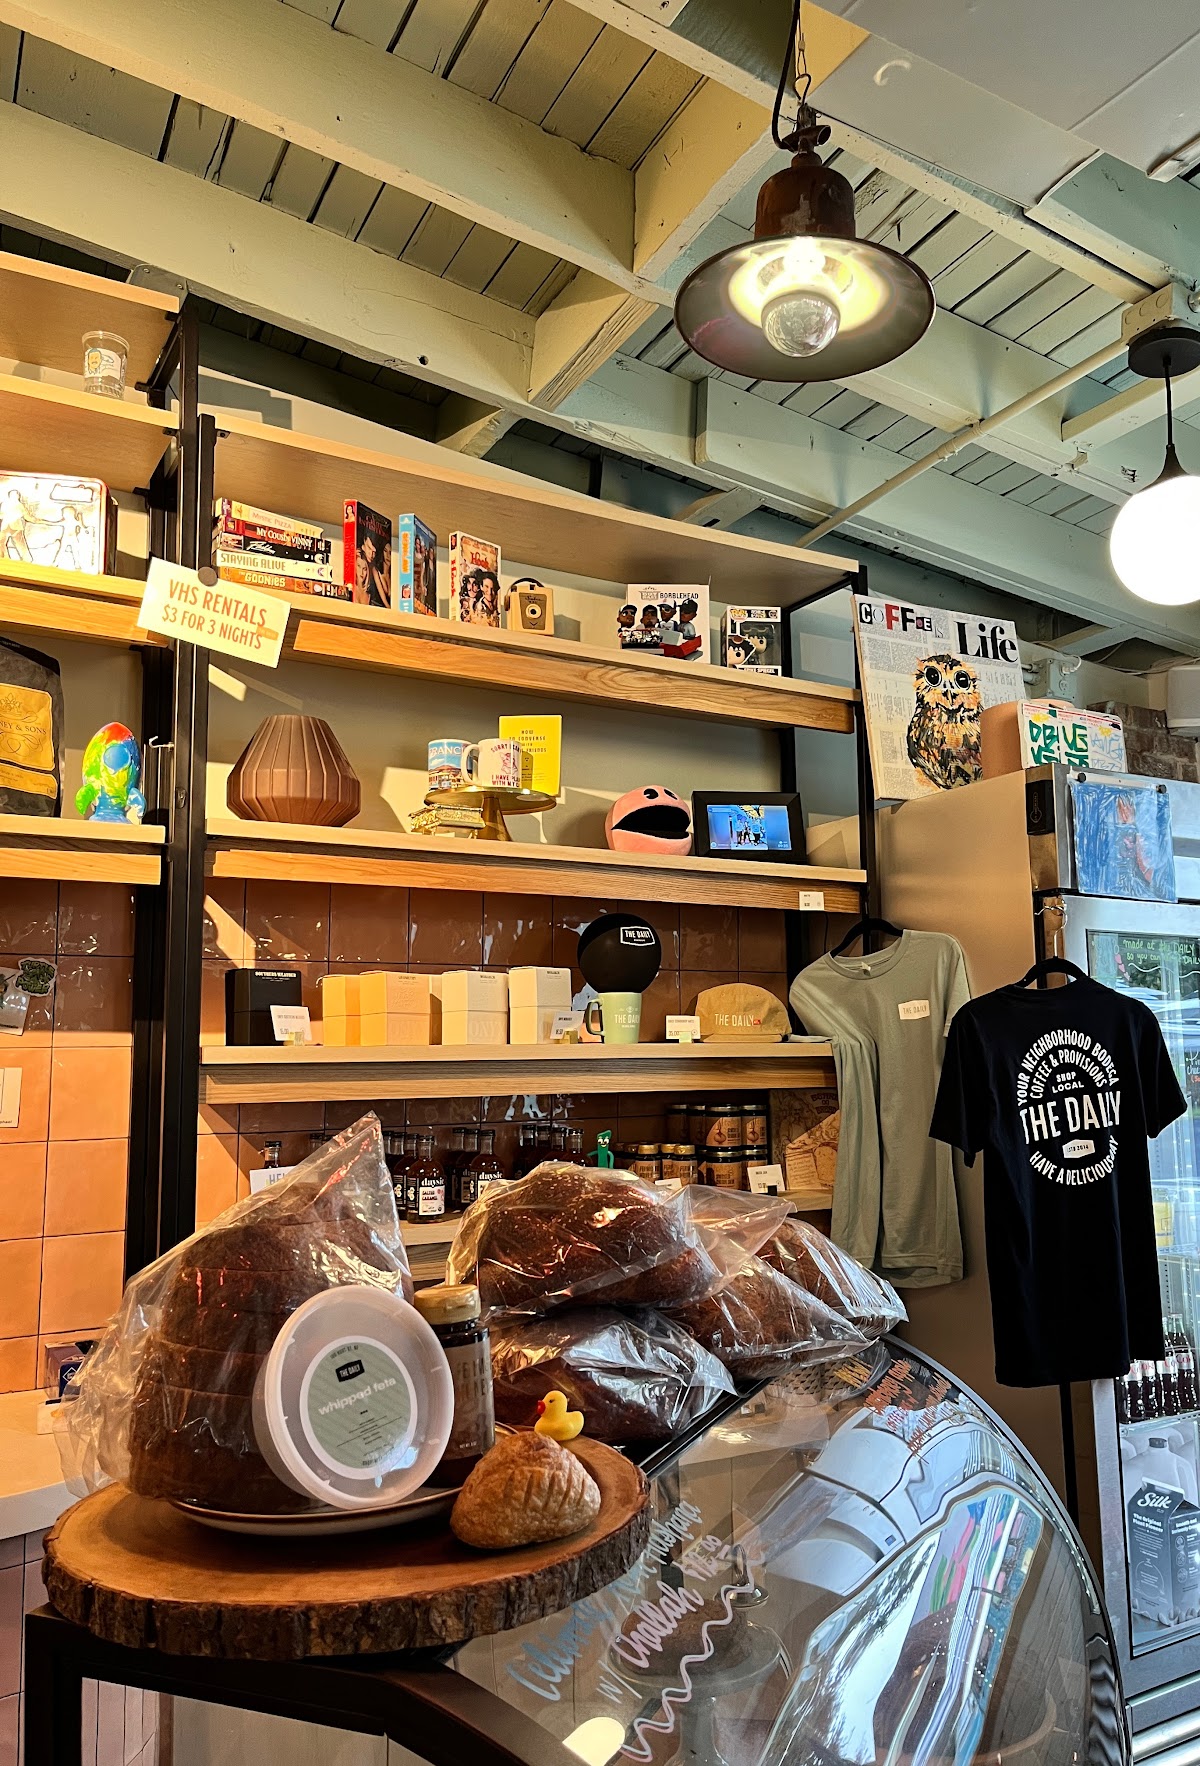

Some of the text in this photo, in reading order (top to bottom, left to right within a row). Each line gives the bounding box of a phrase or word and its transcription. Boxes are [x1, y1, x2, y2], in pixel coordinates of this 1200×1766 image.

[256, 527, 267, 538] MY
[220, 552, 286, 571] STAYING ALIVE
[169, 578, 267, 627] VHS RENTALS
[162, 604, 178, 623] $3
[181, 611, 205, 632] FOR
[207, 619, 216, 635] 3
[219, 622, 263, 650] NIGHTS
[954, 621, 1018, 663] Life
[16, 724, 23, 732] &
[25, 725, 47, 735] SONS
[491, 744, 508, 753] SORRY
[1123, 939, 1143, 949] made
[1147, 942, 1155, 950] at
[1173, 942, 1195, 956] DAILY
[1137, 953, 1148, 964] you
[913, 1004, 927, 1014] DAILY
[614, 1014, 626, 1024] THE
[714, 1013, 754, 1027] THE DAILY
[1017, 1029, 1119, 1106] YOUR NEIGHBORHOOD BODEGA
[1030, 1049, 1107, 1099] COFFEE & PROVISIONS
[1056, 1071, 1076, 1083] SHOP
[1052, 1081, 1084, 1093] LOCAL
[1019, 1090, 1121, 1145] THE DAILY
[1029, 1150, 1057, 1180] HAVE
[1056, 1168, 1064, 1184] A
[1066, 1156, 1114, 1186] DELICIOUS
[339, 1364, 361, 1378] THE DAILY
[318, 1376, 397, 1416] whipped feta
[1137, 1492, 1172, 1509] Silk
[609, 1580, 704, 1668] Challah
[596, 1658, 642, 1704] w/
